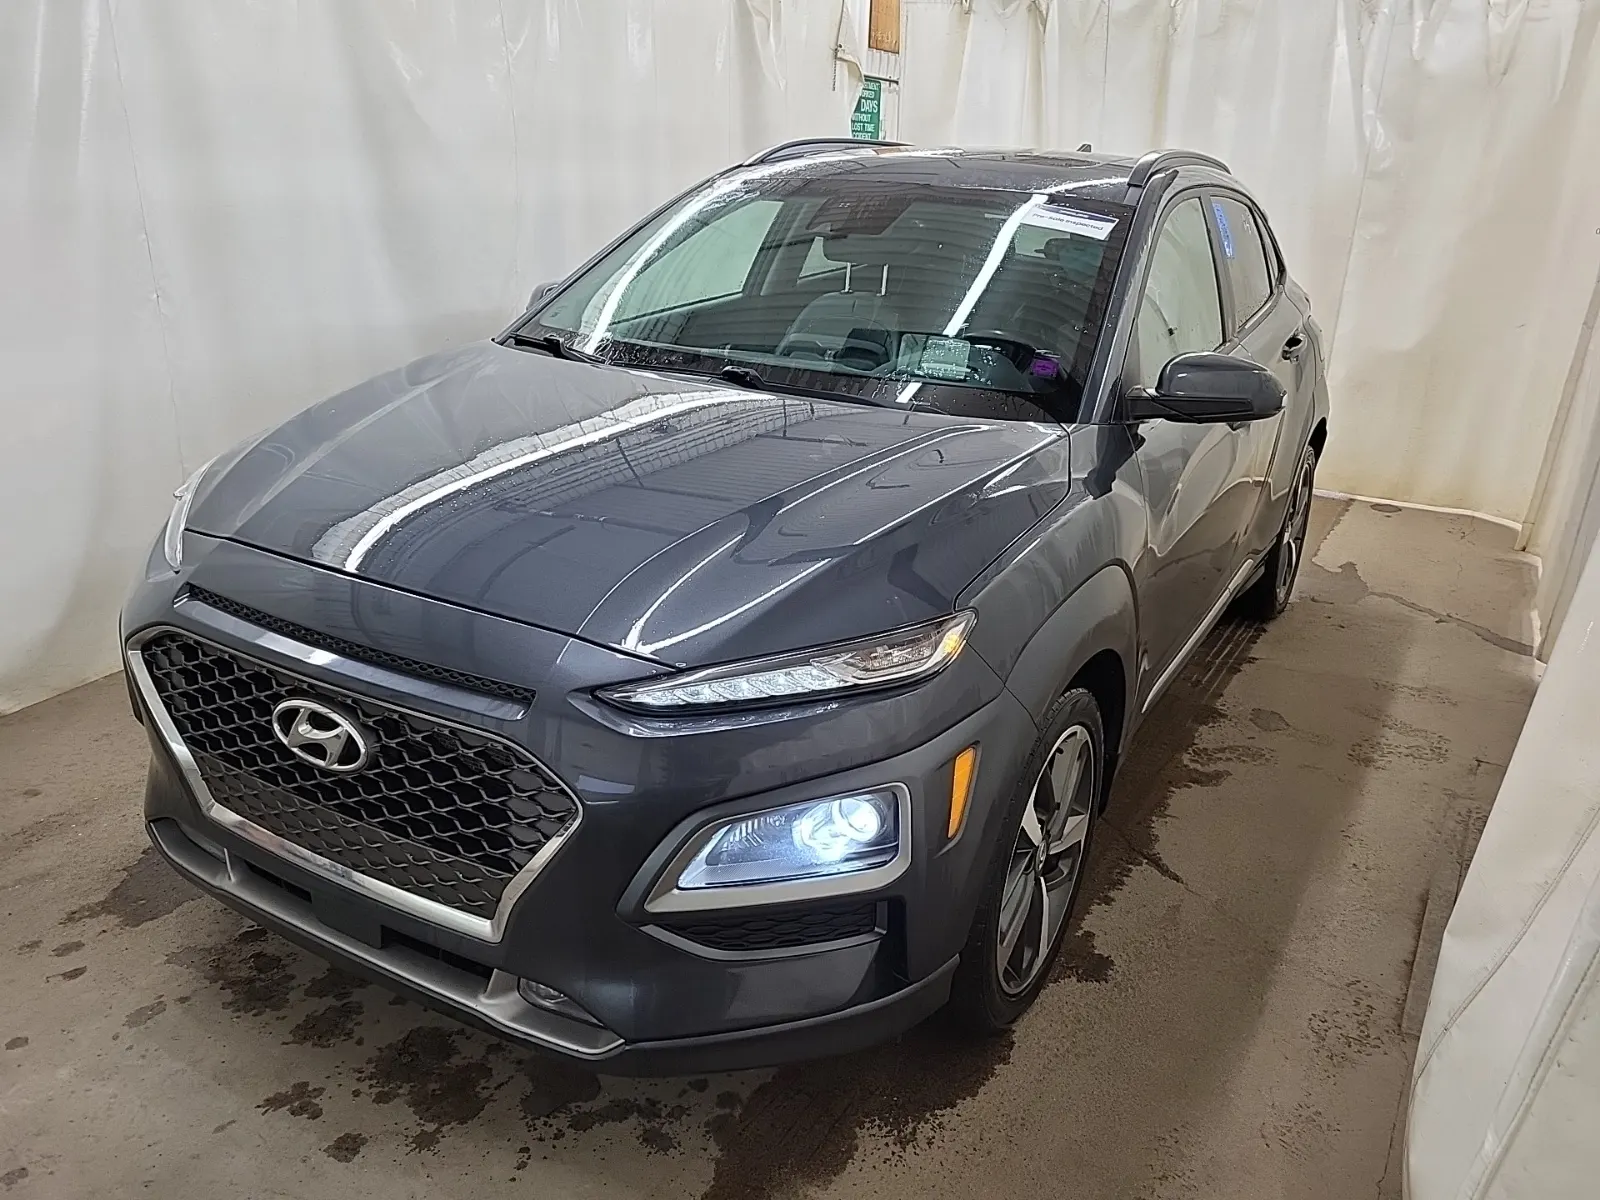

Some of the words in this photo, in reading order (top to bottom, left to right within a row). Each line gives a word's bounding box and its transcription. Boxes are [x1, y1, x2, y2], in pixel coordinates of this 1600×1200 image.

[861, 99, 878, 113] DAYS
[852, 121, 863, 131] LOST
[864, 123, 875, 132] TIME
[853, 131, 871, 140] CCIDENT
